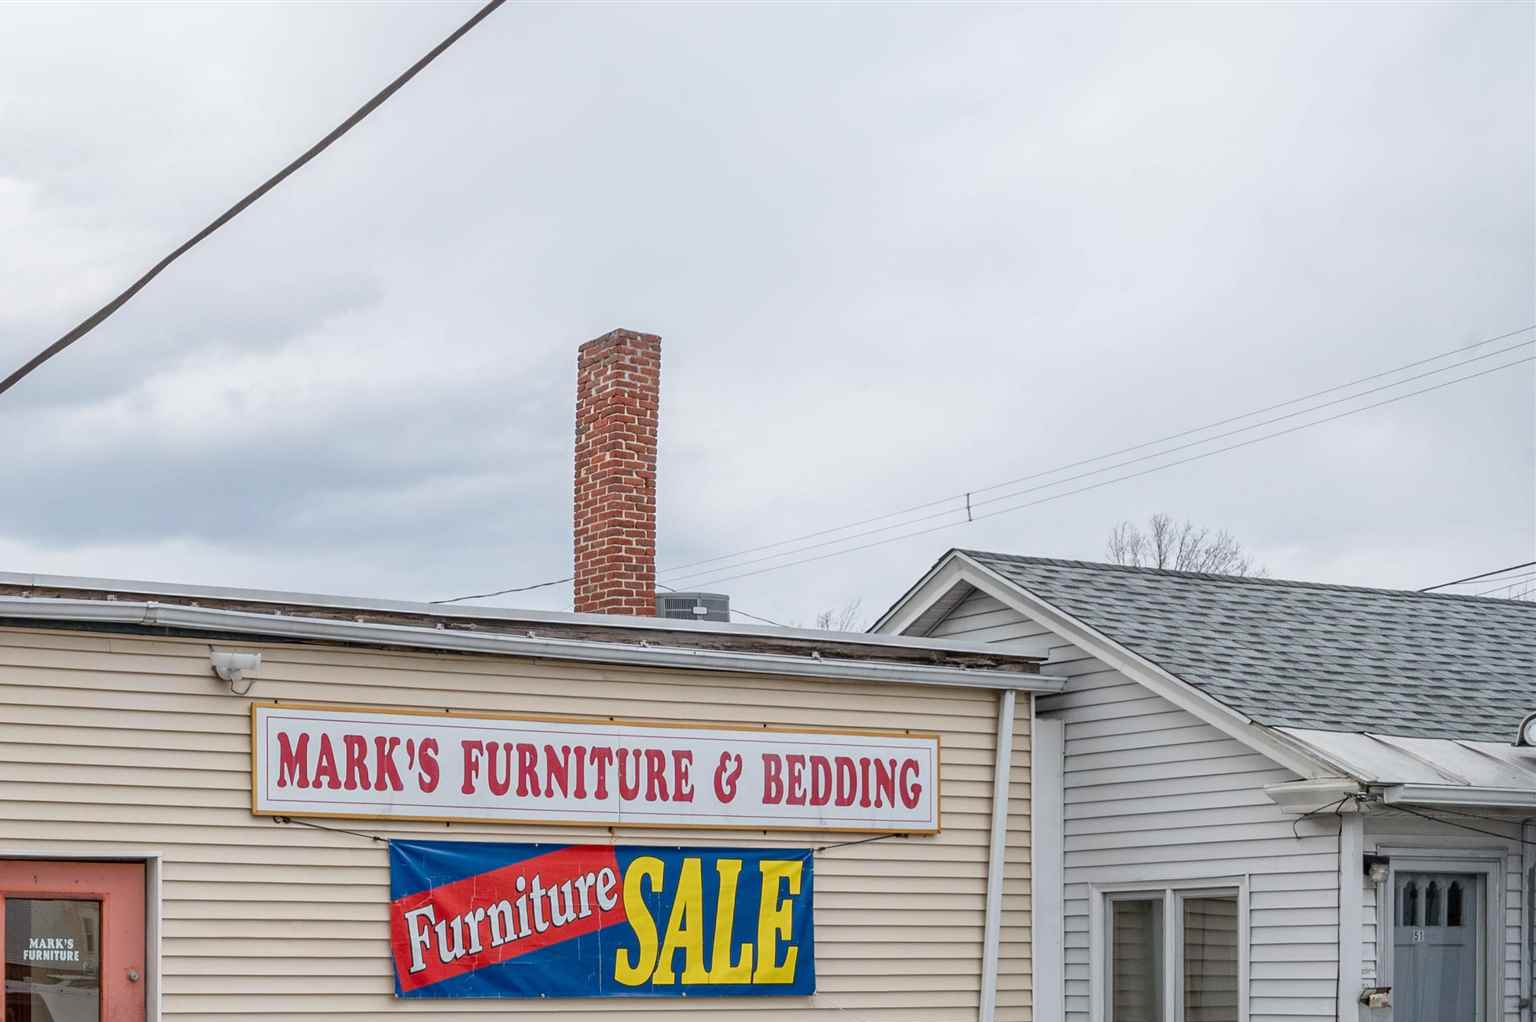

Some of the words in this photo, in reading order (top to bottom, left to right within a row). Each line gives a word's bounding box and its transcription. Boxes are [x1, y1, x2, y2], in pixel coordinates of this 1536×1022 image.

[276, 732, 440, 793] MARK'S
[461, 739, 694, 803] FURNITURE
[713, 751, 743, 804] &
[762, 753, 922, 809] BEDDING
[404, 866, 620, 974] Furniture
[613, 856, 804, 986] SALE
[23, 949, 80, 961] FURNITURE
[29, 938, 74, 949] MARK'S
